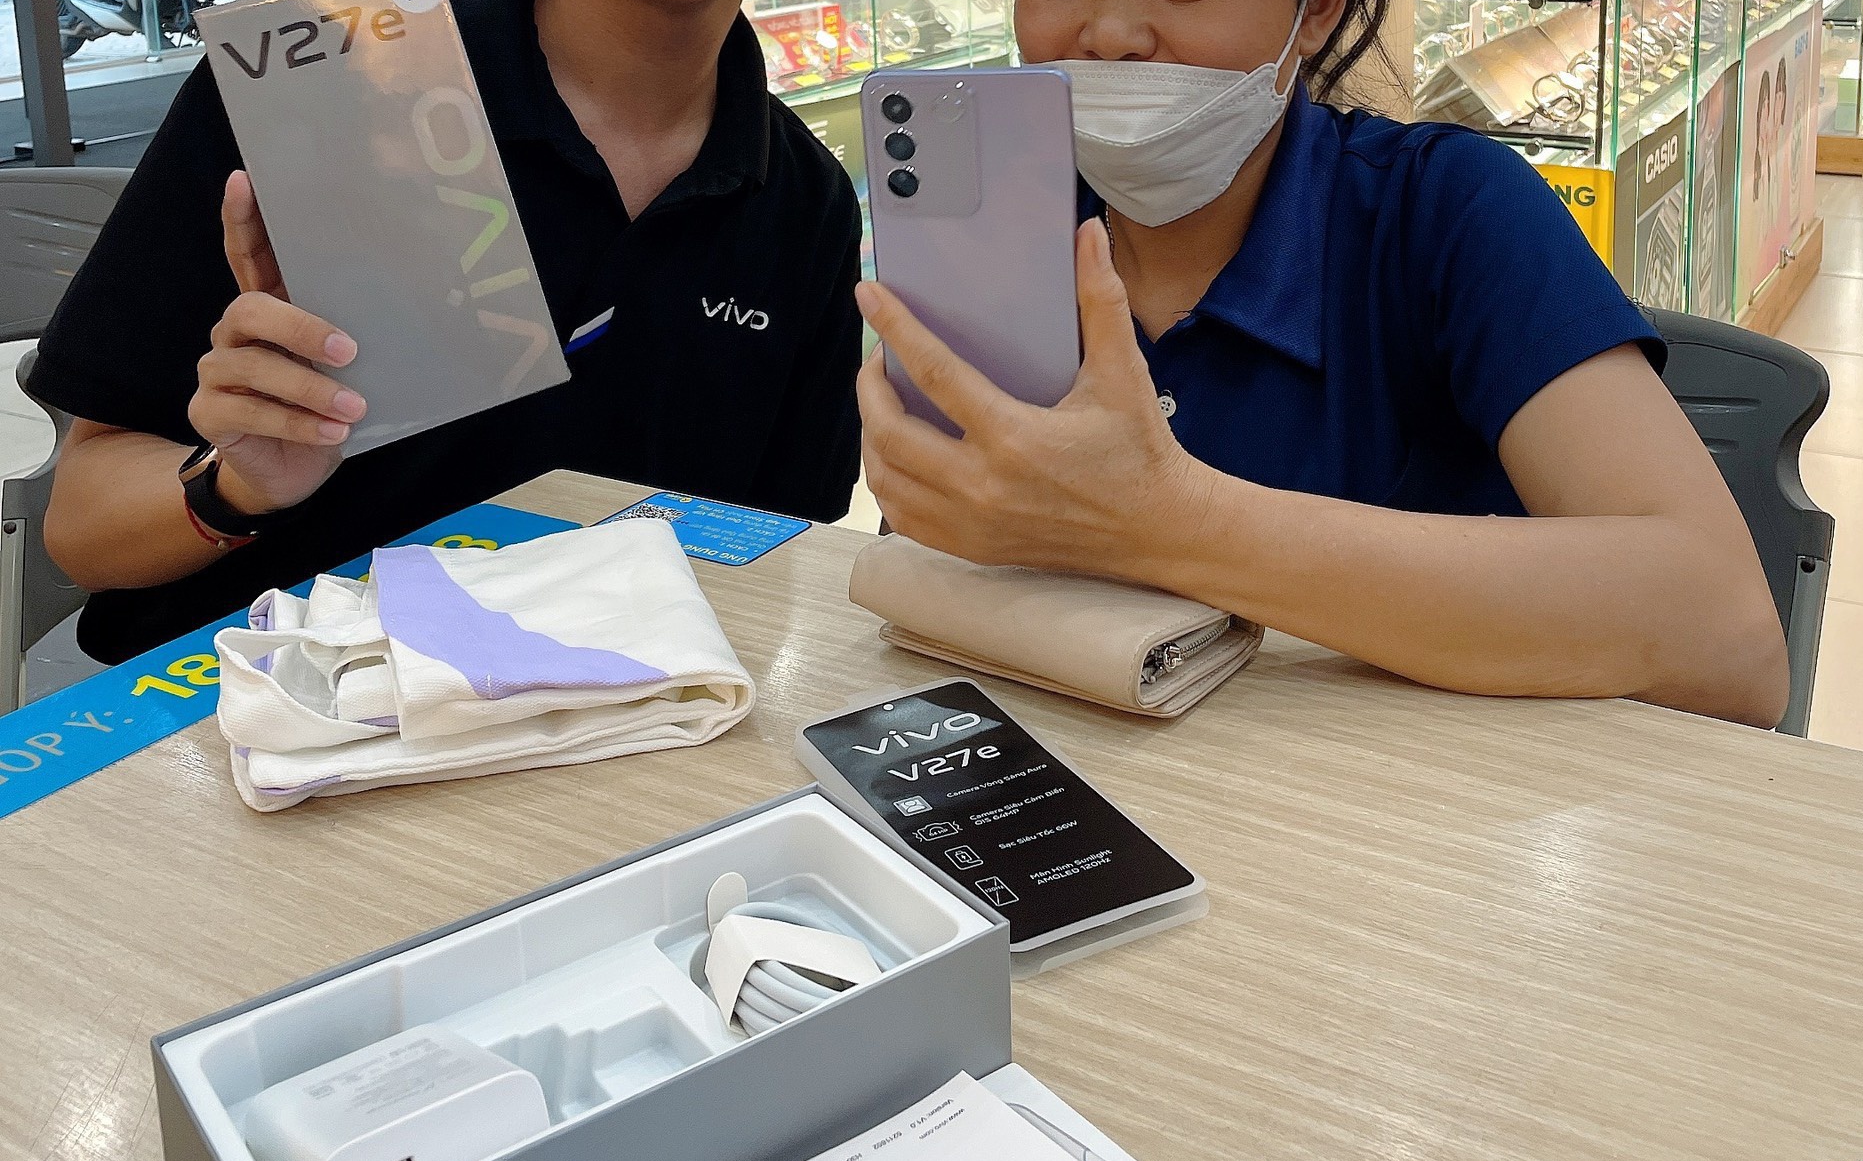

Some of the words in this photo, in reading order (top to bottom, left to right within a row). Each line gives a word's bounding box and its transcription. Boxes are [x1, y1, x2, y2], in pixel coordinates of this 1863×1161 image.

[221, 5, 407, 80] V27e
[1645, 134, 1678, 184] CASIO
[1555, 184, 1596, 207] NG
[411, 85, 552, 400] vivo
[701, 296, 770, 331] vivo
[851, 712, 982, 755] vivo
[887, 745, 1001, 782] V27e
[946, 786, 980, 798] Camera
[1027, 763, 1048, 774] Aura
[969, 808, 1004, 821] Camera
[1003, 801, 1024, 811] Siêu
[974, 818, 992, 826] OIS
[992, 808, 1020, 821] 64MP
[1016, 835, 1037, 845] Siêu
[1055, 820, 1078, 832] 66W
[1037, 867, 1080, 885] AMOLED
[1080, 857, 1112, 871] 120Hz
[1074, 849, 1113, 866] Sunlight
